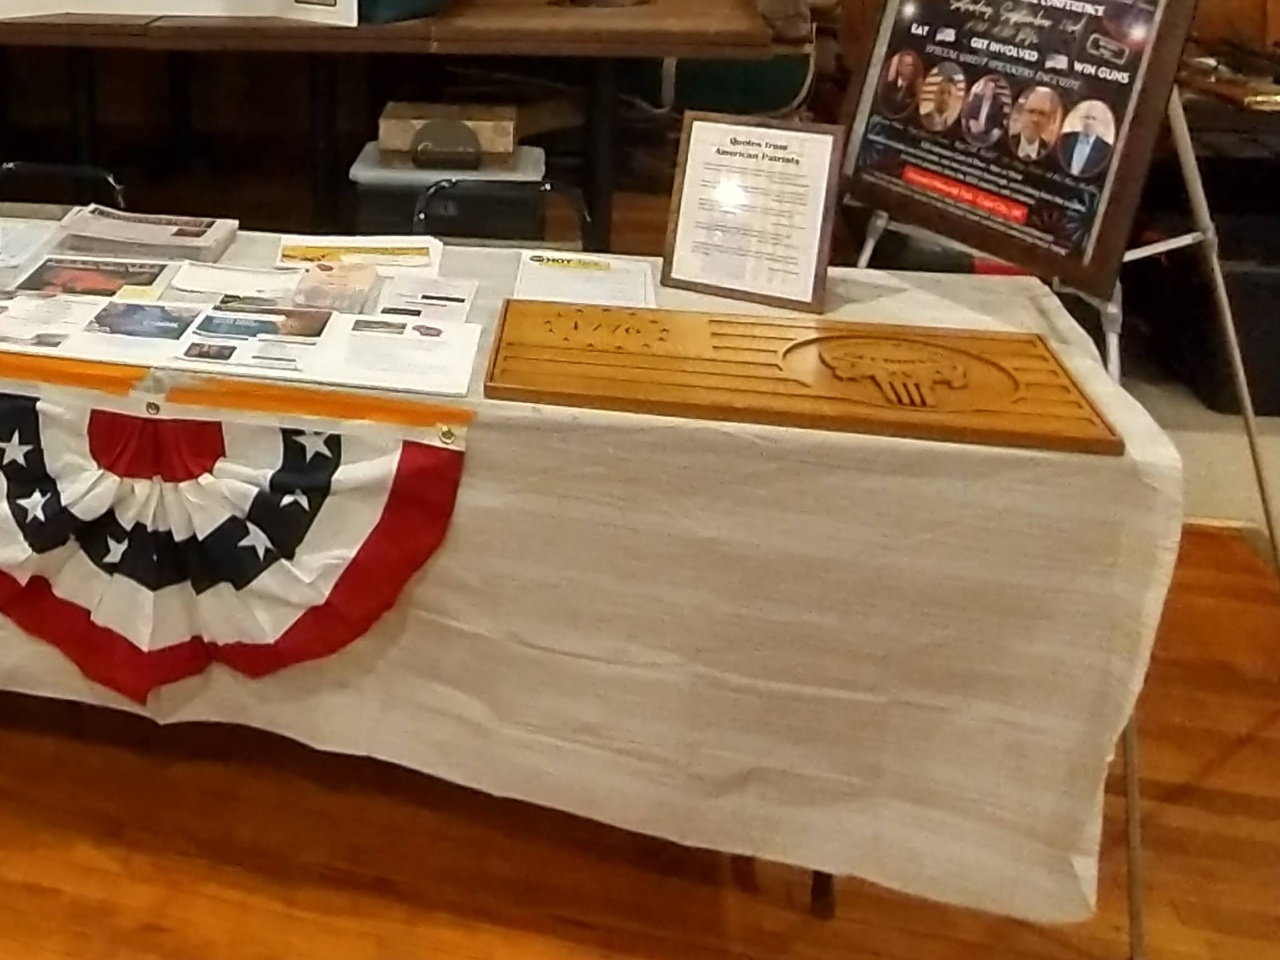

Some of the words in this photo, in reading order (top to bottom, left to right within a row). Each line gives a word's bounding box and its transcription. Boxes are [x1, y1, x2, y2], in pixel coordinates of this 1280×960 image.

[910, 23, 930, 38] EAT
[969, 36, 991, 52] GET
[989, 40, 1040, 63] INVOLVED
[1072, 59, 1097, 77] WIN
[1096, 66, 1132, 85] GUNS
[729, 136, 763, 149] Quotes
[714, 146, 759, 161] American
[761, 152, 801, 166] Patriots
